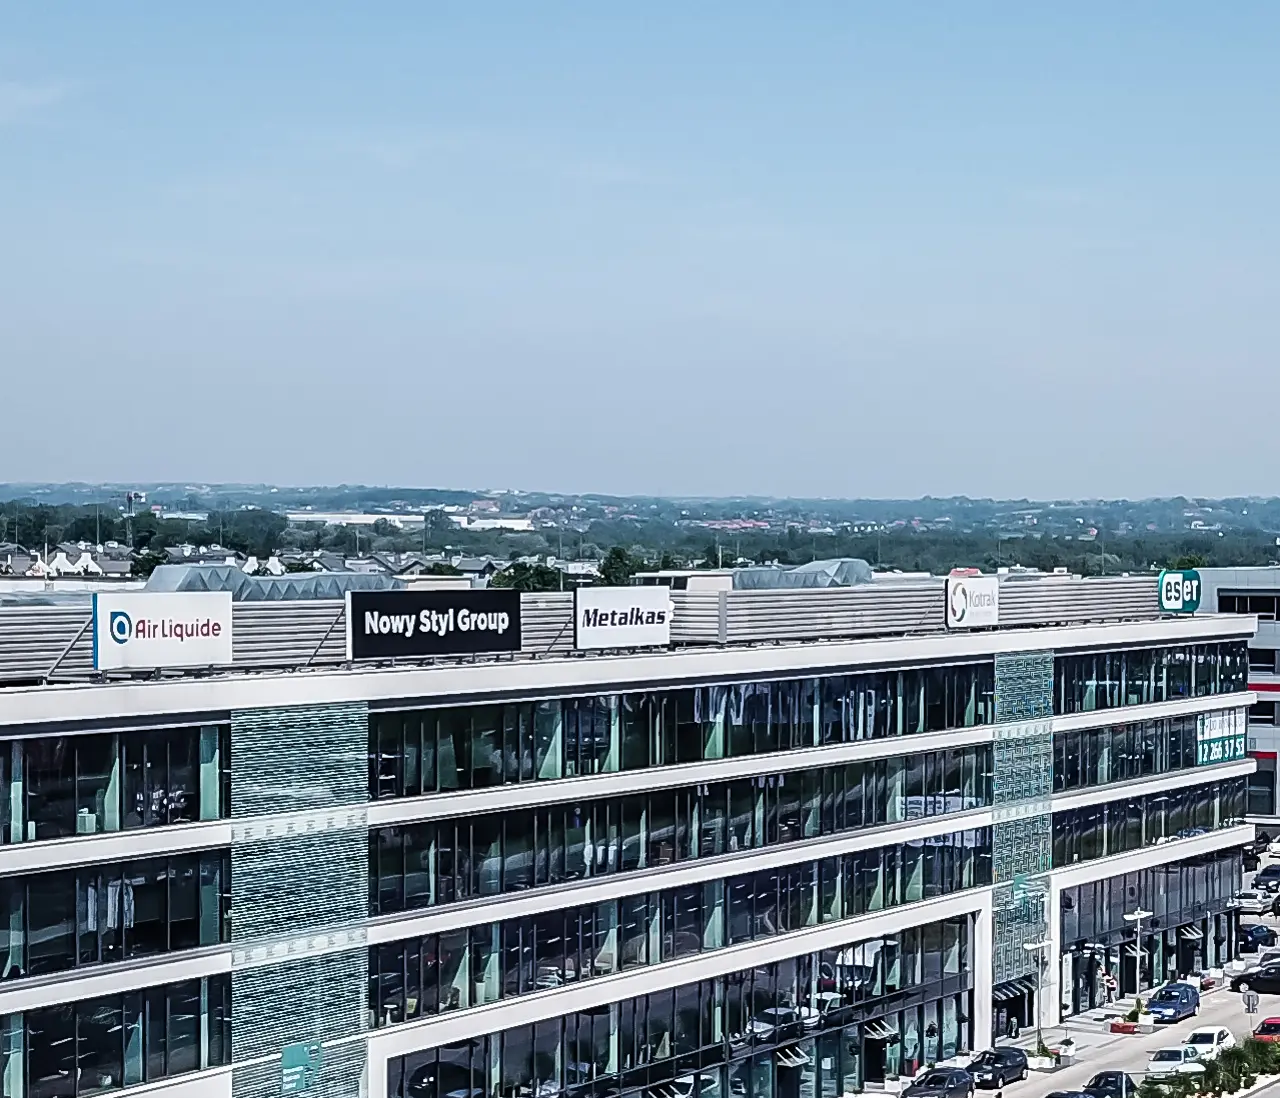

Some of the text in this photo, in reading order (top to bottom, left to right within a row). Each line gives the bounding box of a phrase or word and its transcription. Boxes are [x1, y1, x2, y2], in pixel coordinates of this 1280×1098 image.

[364, 608, 509, 638] Nowy Styl Group
[582, 607, 666, 628] Metalkas
[135, 618, 222, 642] Air Liquide
